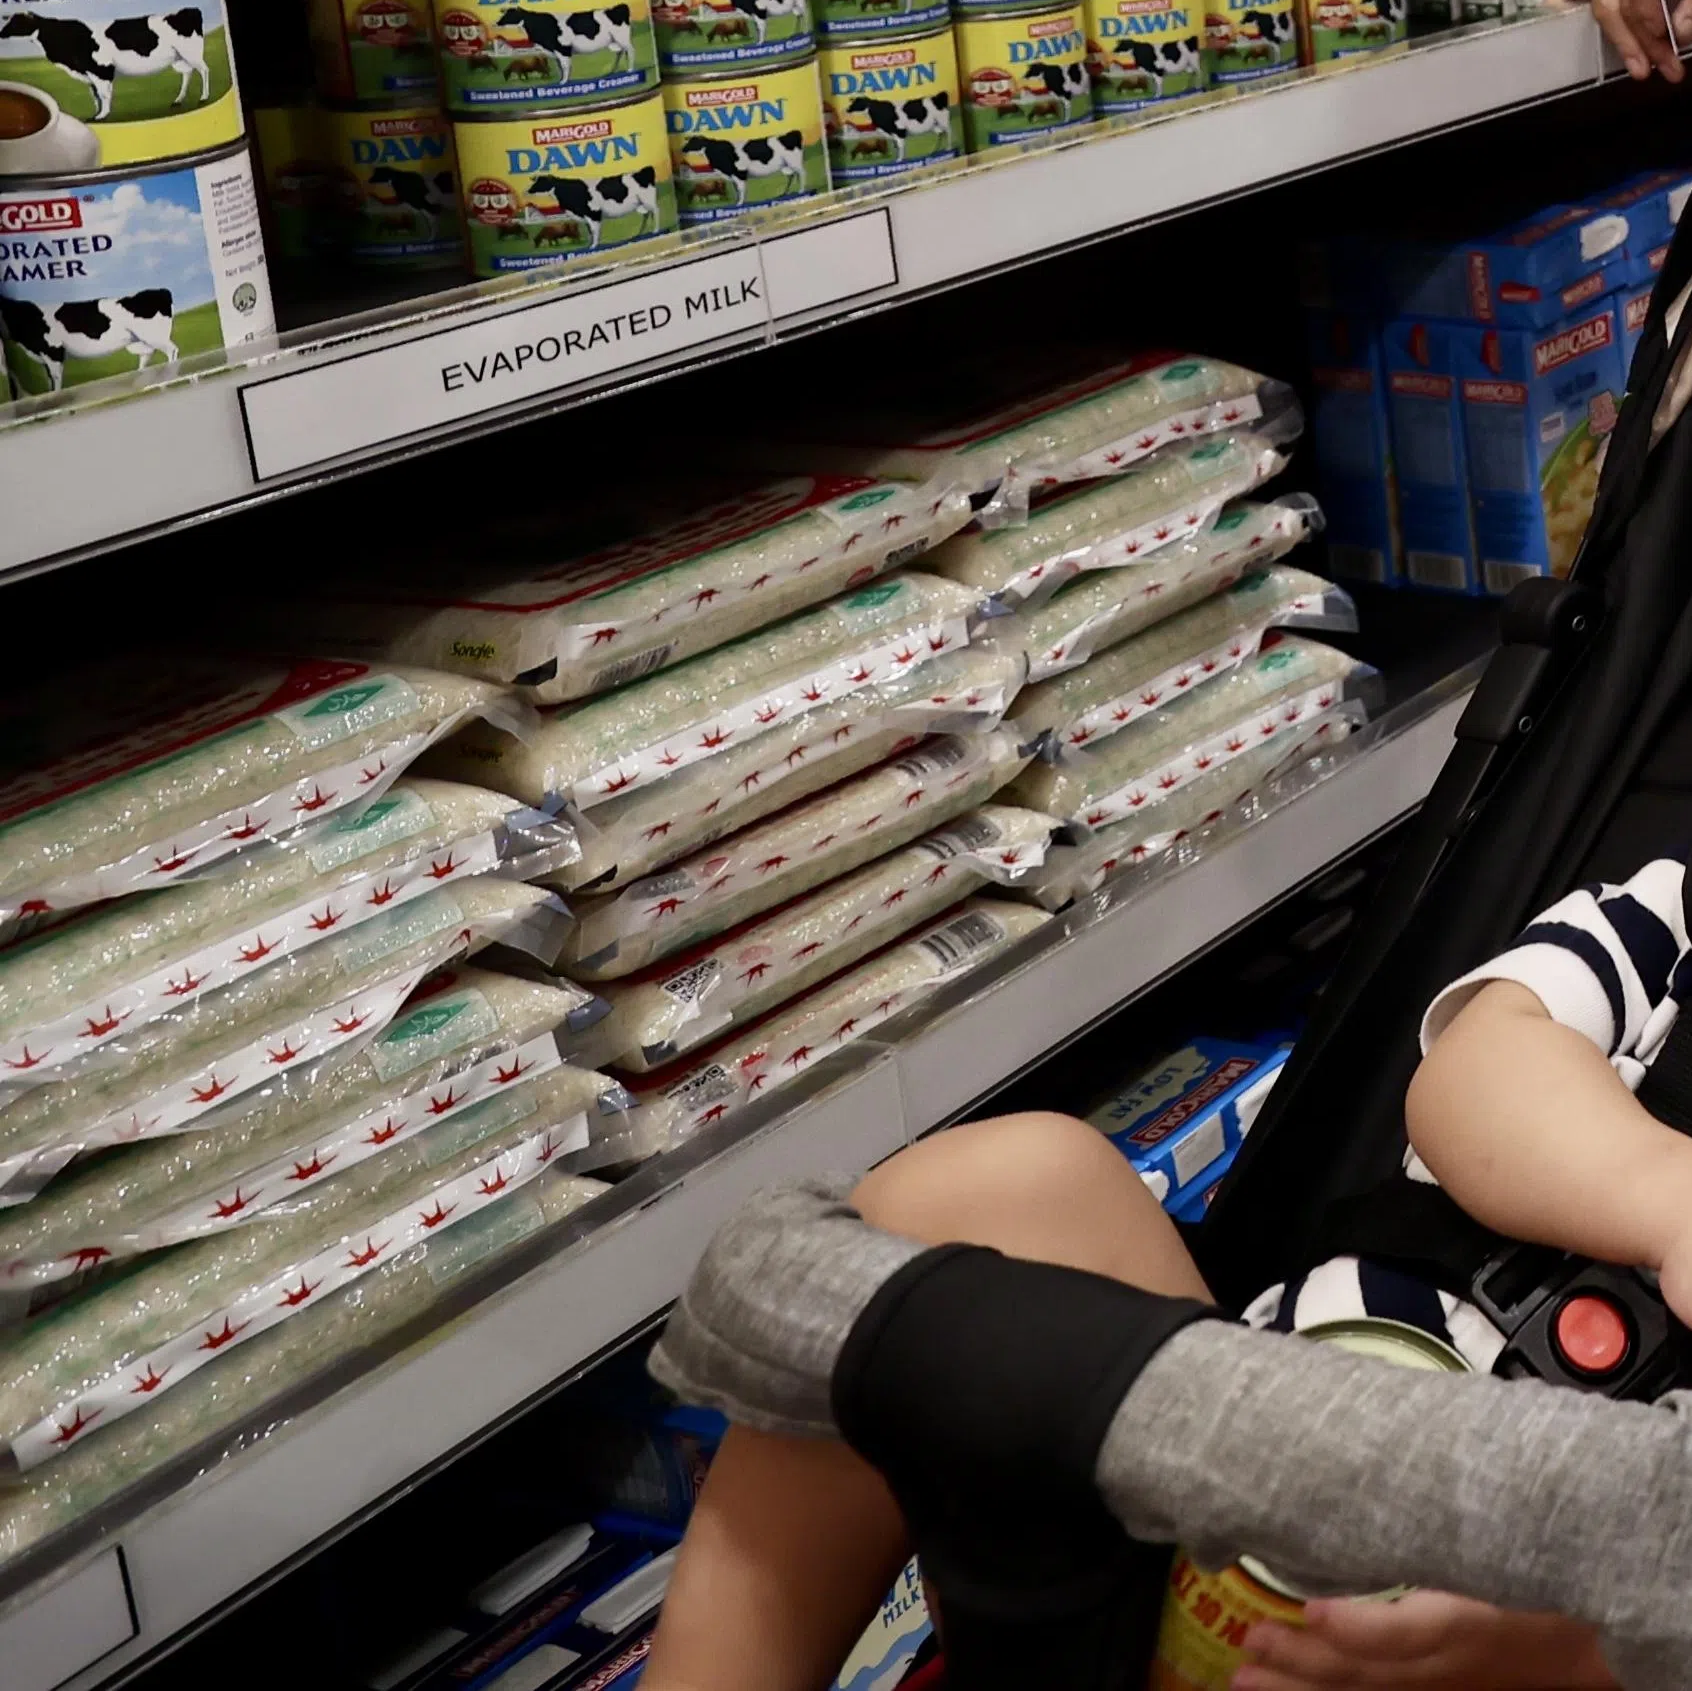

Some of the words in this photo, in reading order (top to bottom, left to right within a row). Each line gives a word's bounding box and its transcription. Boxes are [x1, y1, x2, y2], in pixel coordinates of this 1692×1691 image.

[470, 83, 533, 102] Sweetened
[536, 78, 596, 98] Beverage
[830, 62, 936, 96] DAWN
[667, 100, 784, 134] DAWN
[506, 133, 640, 175] DAWN
[441, 303, 671, 393] EVAPORATED
[684, 275, 764, 320] MILK
[1535, 319, 1607, 368] MARIGOLD
[883, 1587, 922, 1629] MILK
